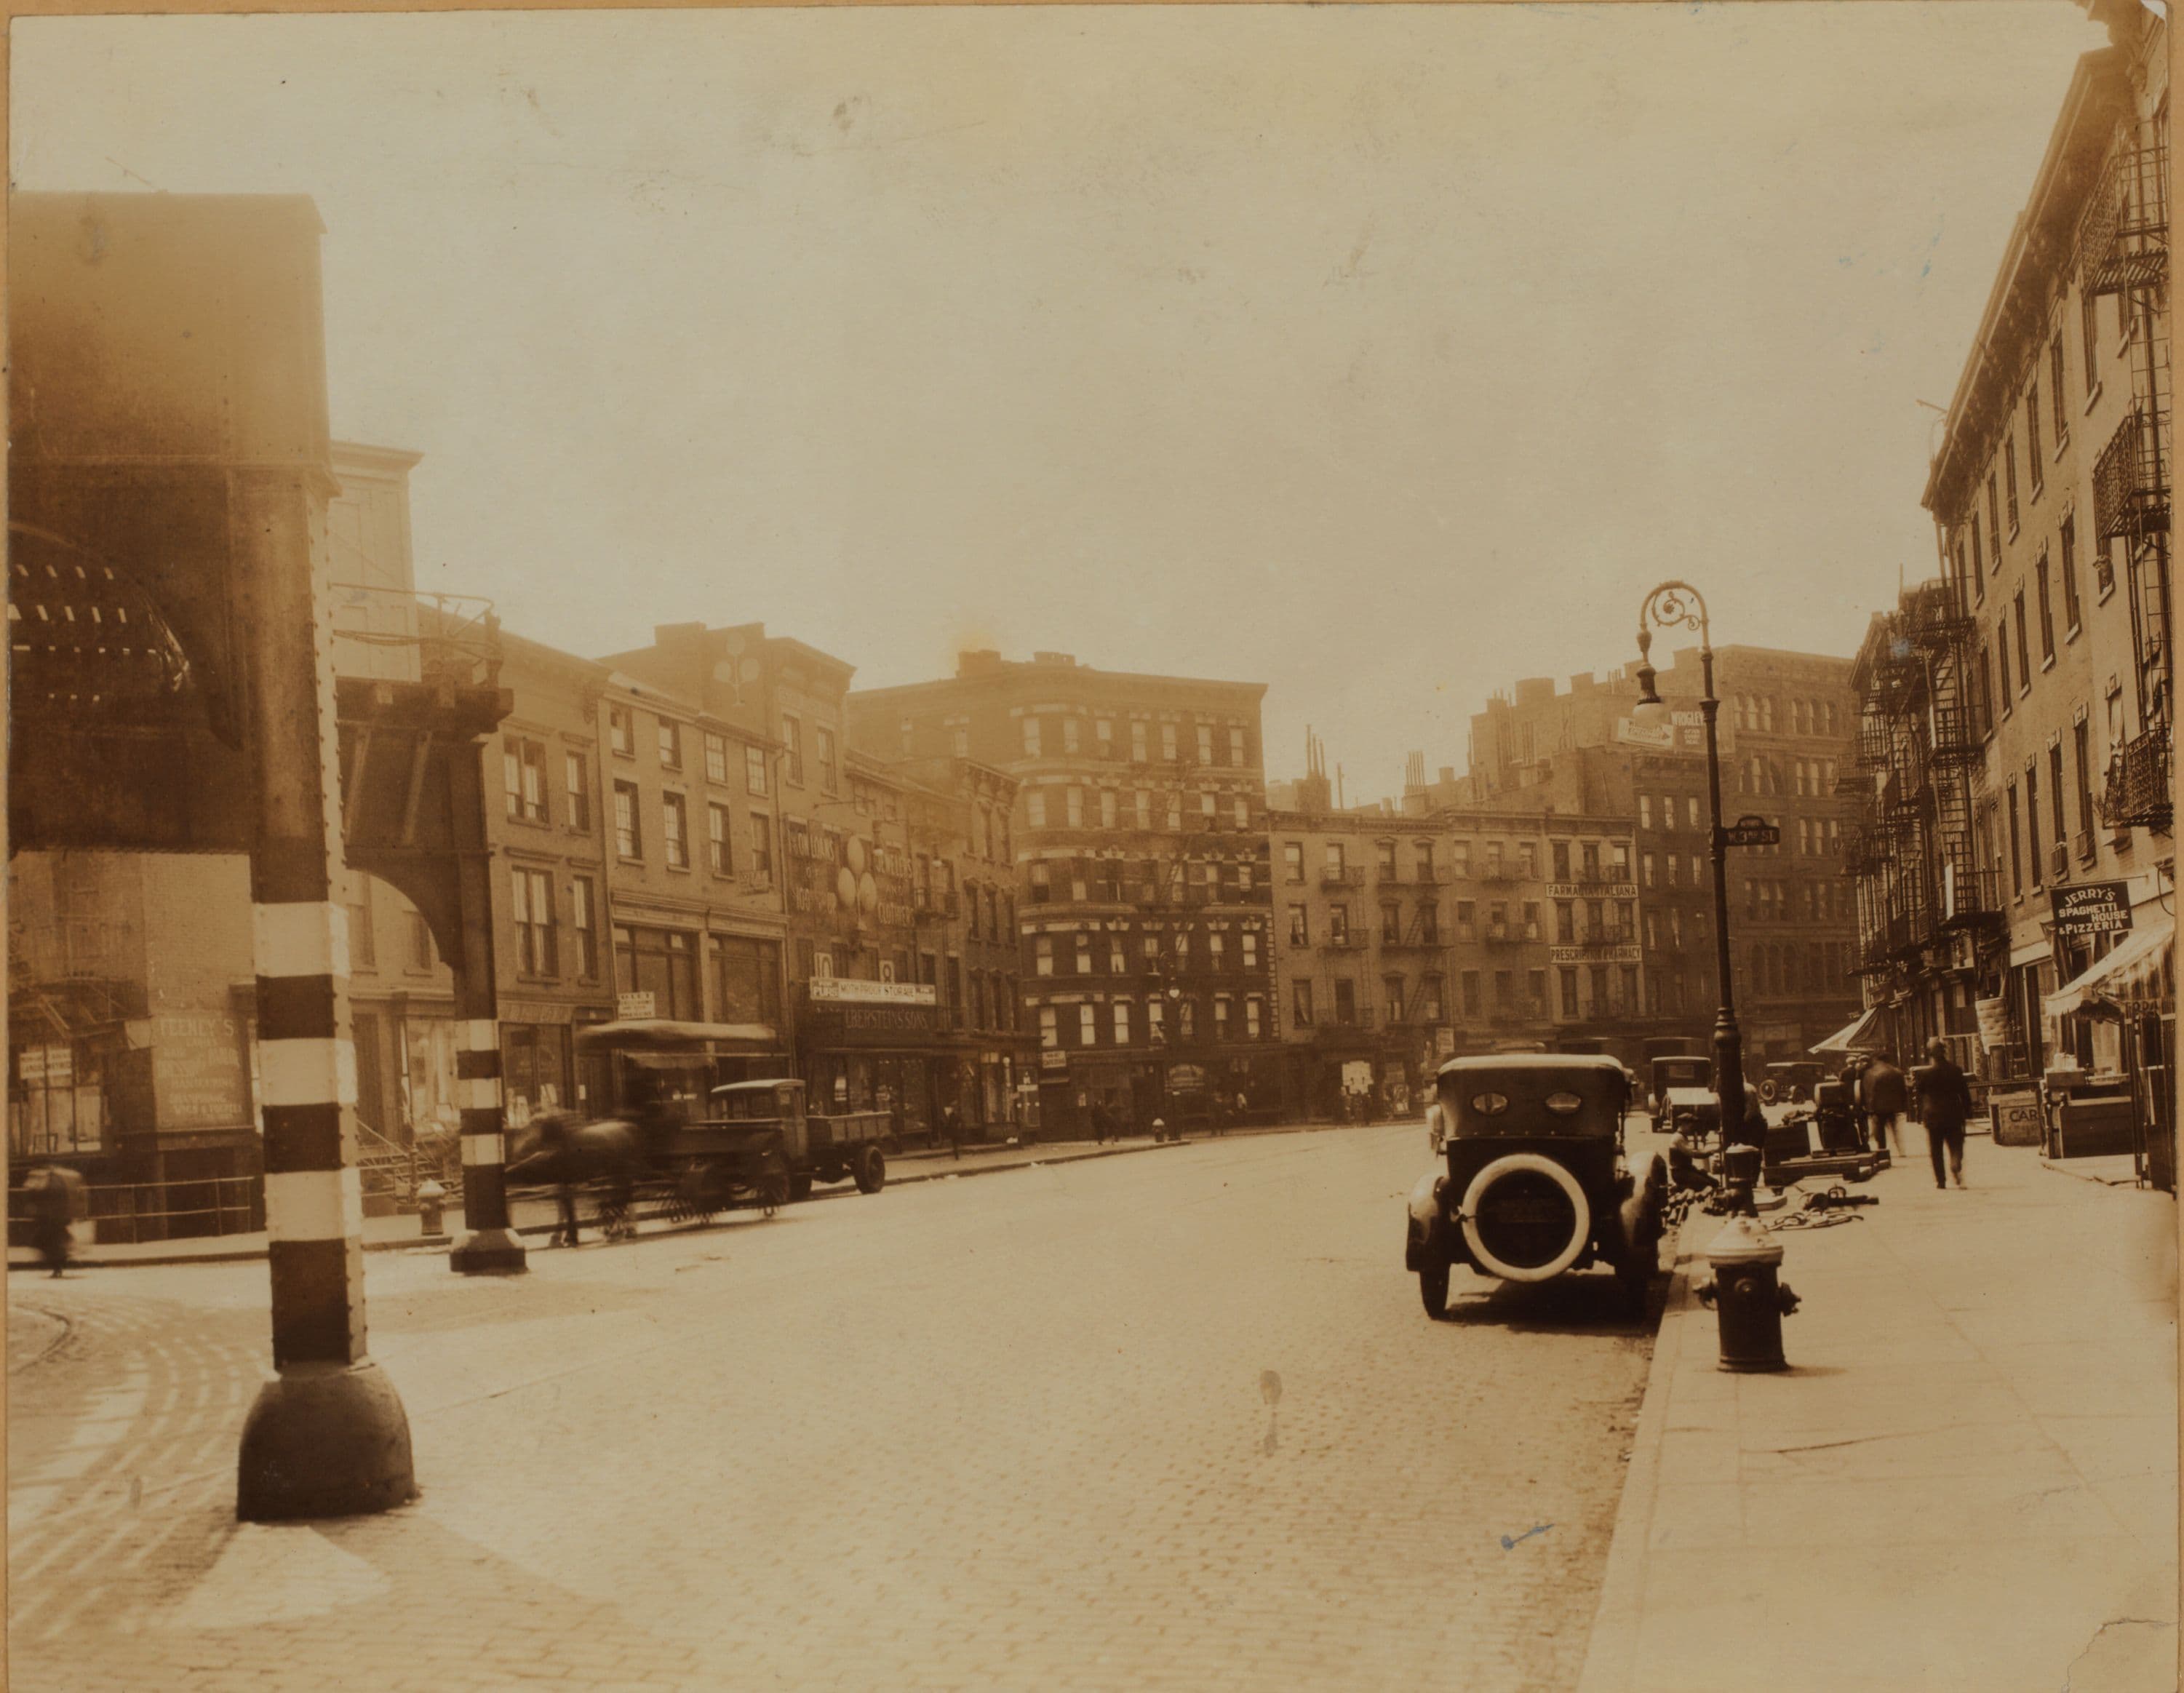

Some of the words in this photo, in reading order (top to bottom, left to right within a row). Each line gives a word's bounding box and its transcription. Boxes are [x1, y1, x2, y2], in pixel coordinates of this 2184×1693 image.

[2064, 888, 2116, 907] JERRY'S
[2058, 902, 2117, 917] SPAGHETTI
[2091, 910, 2128, 922] HOUSE
[2065, 920, 2123, 934] PIZZERIA
